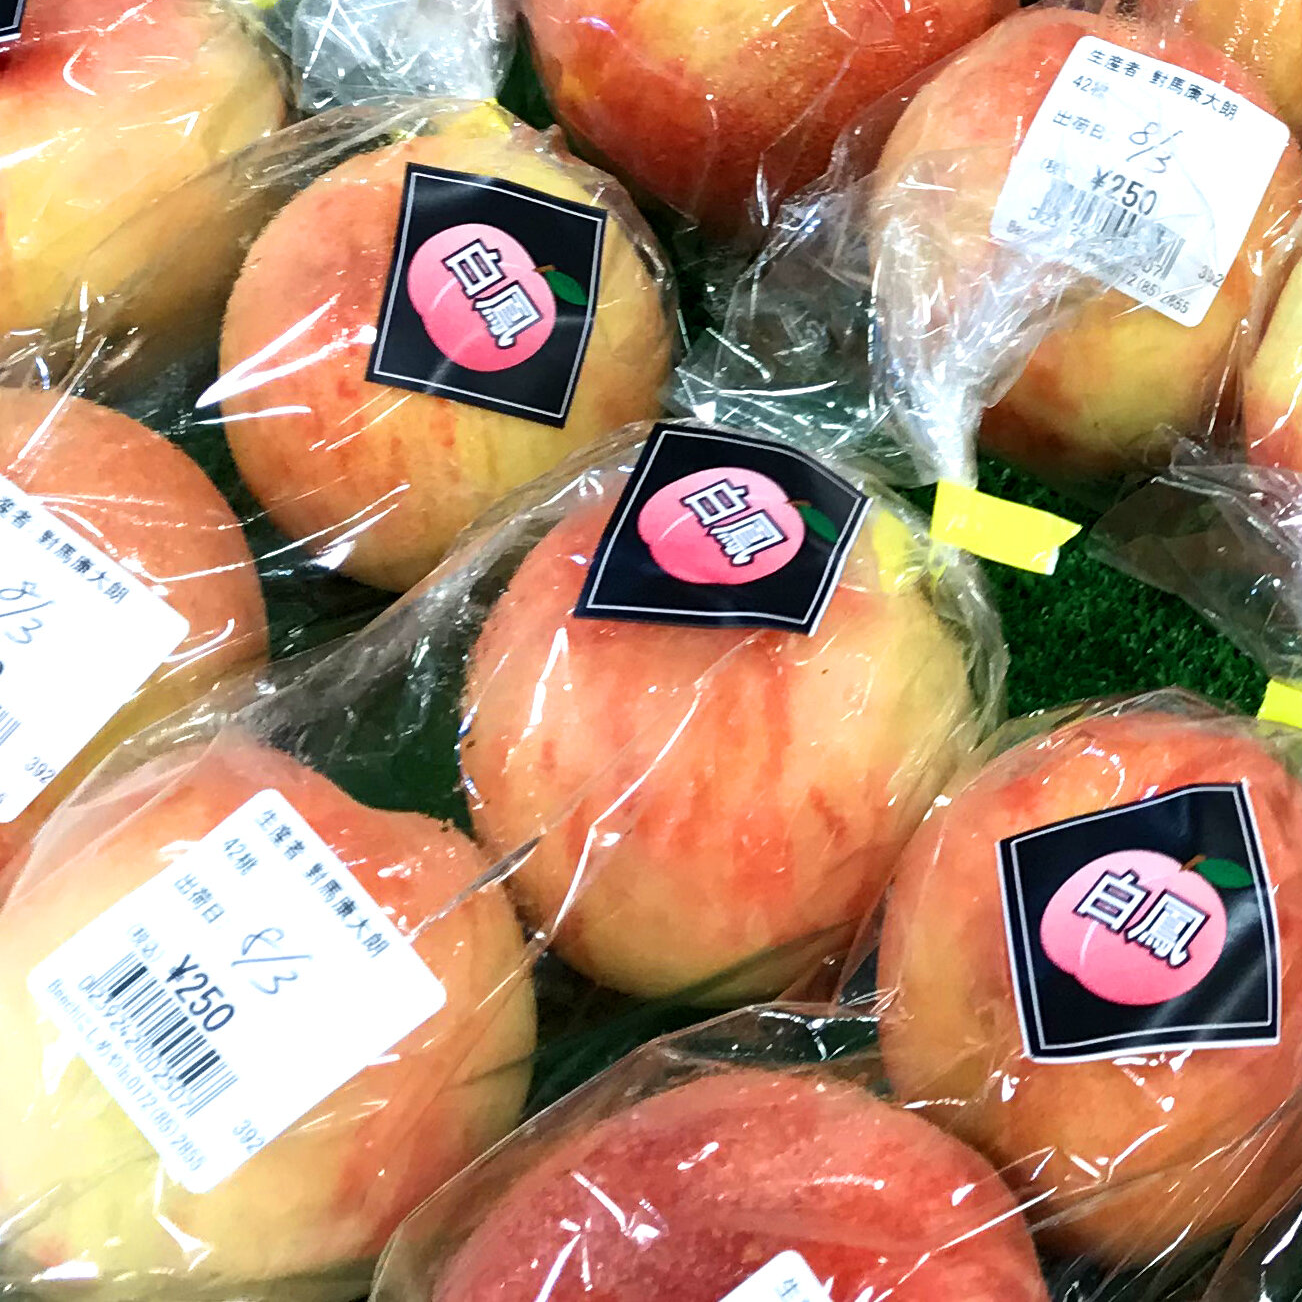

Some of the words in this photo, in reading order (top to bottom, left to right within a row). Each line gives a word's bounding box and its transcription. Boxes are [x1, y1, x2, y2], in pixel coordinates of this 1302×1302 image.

[1126, 122, 1183, 174] 8/3
[1091, 165, 1158, 216] ¥250
[442, 238, 544, 350] 白鳳
[681, 478, 789, 566] 白鳳
[24, 756, 56, 785] 392
[1074, 869, 1209, 968] 白鳳
[165, 953, 235, 1033] ¥250
[231, 927, 313, 995] 8/3
[232, 1119, 267, 1154] 392
